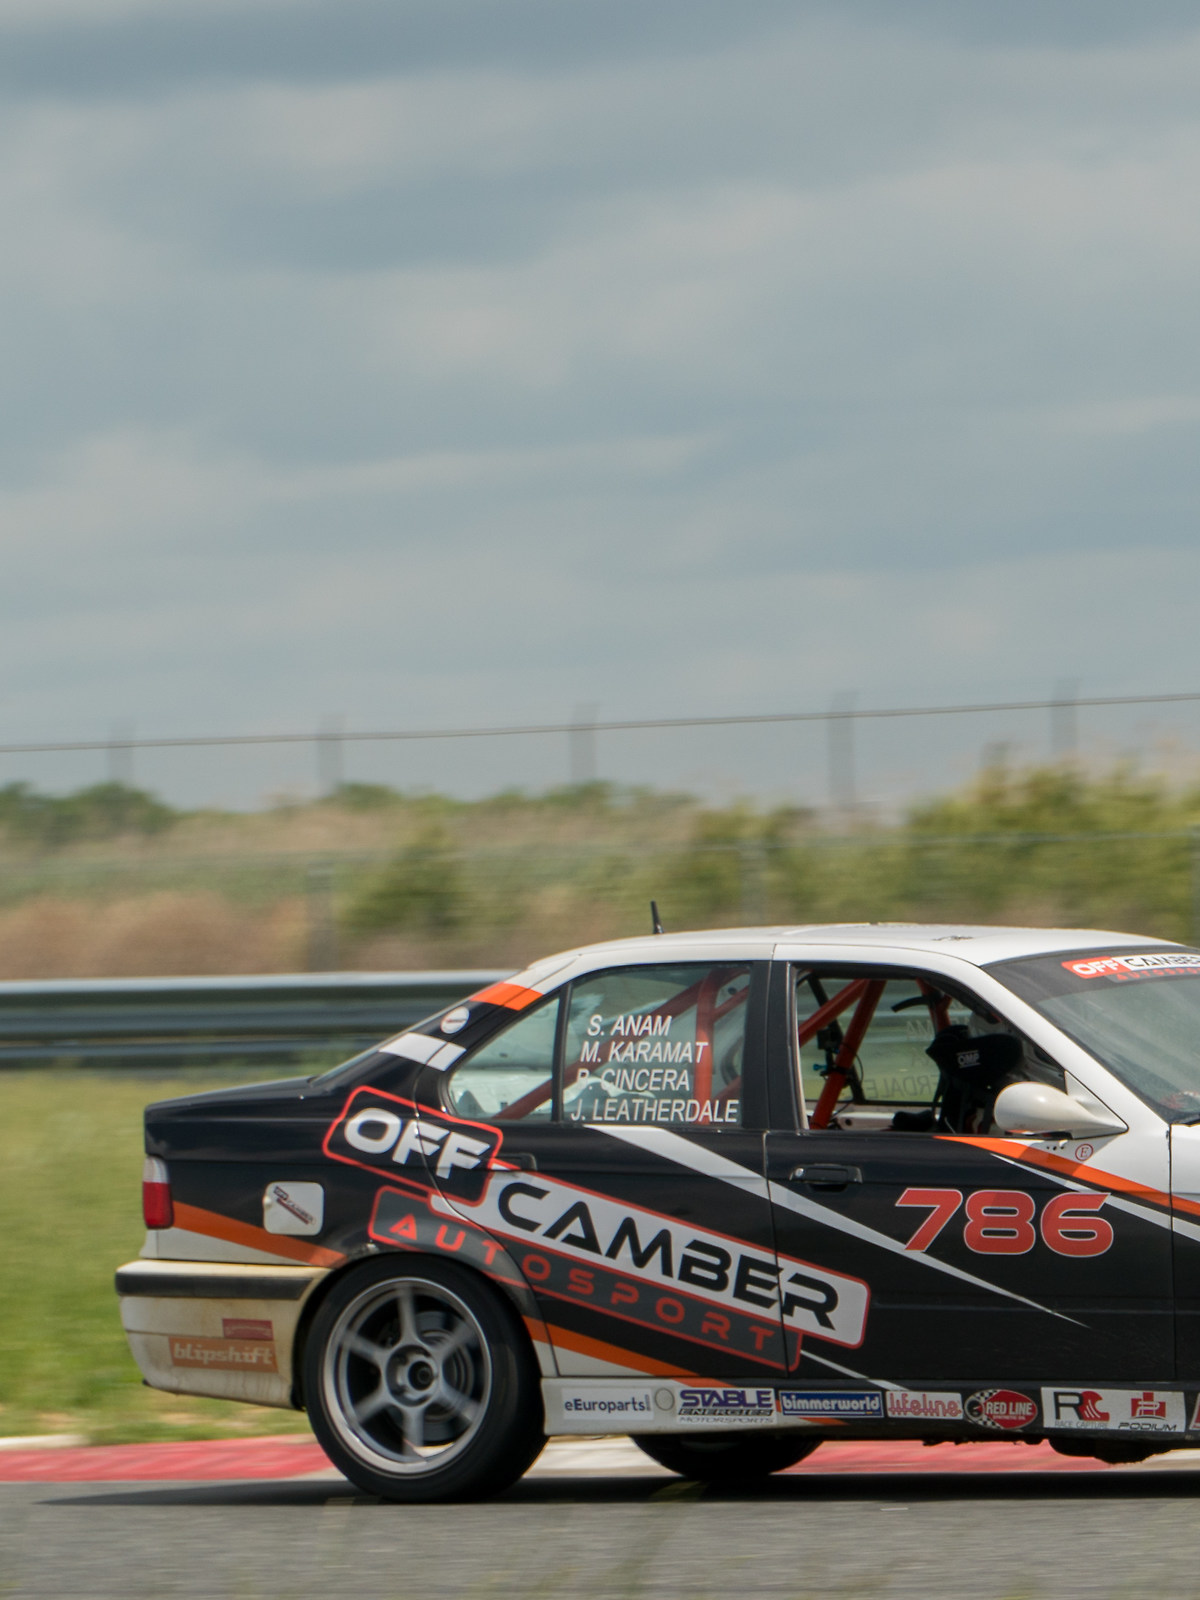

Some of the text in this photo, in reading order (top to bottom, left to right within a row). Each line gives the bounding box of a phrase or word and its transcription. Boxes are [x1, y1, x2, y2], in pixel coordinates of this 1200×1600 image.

[1072, 958, 1119, 974] OFF
[587, 1014, 672, 1036] S. ANAM
[580, 1041, 709, 1063] M. KARAMAT
[600, 1068, 691, 1092] CINCERA
[570, 1099, 740, 1123] J. LEATHERDALE
[344, 1107, 839, 1331] OFF CAMBER
[895, 1187, 1114, 1258] 786
[389, 1213, 776, 1351] AUTOSPORT
[174, 1343, 273, 1365] blipshift
[680, 1389, 773, 1408] STABLE
[783, 1395, 880, 1411] bimmerworld
[888, 1392, 962, 1417] lifeline
[986, 1401, 1033, 1415] RED LINE
[1055, 1420, 1109, 1429] RACE CAPTURE
[1119, 1422, 1177, 1432] PODIUM
